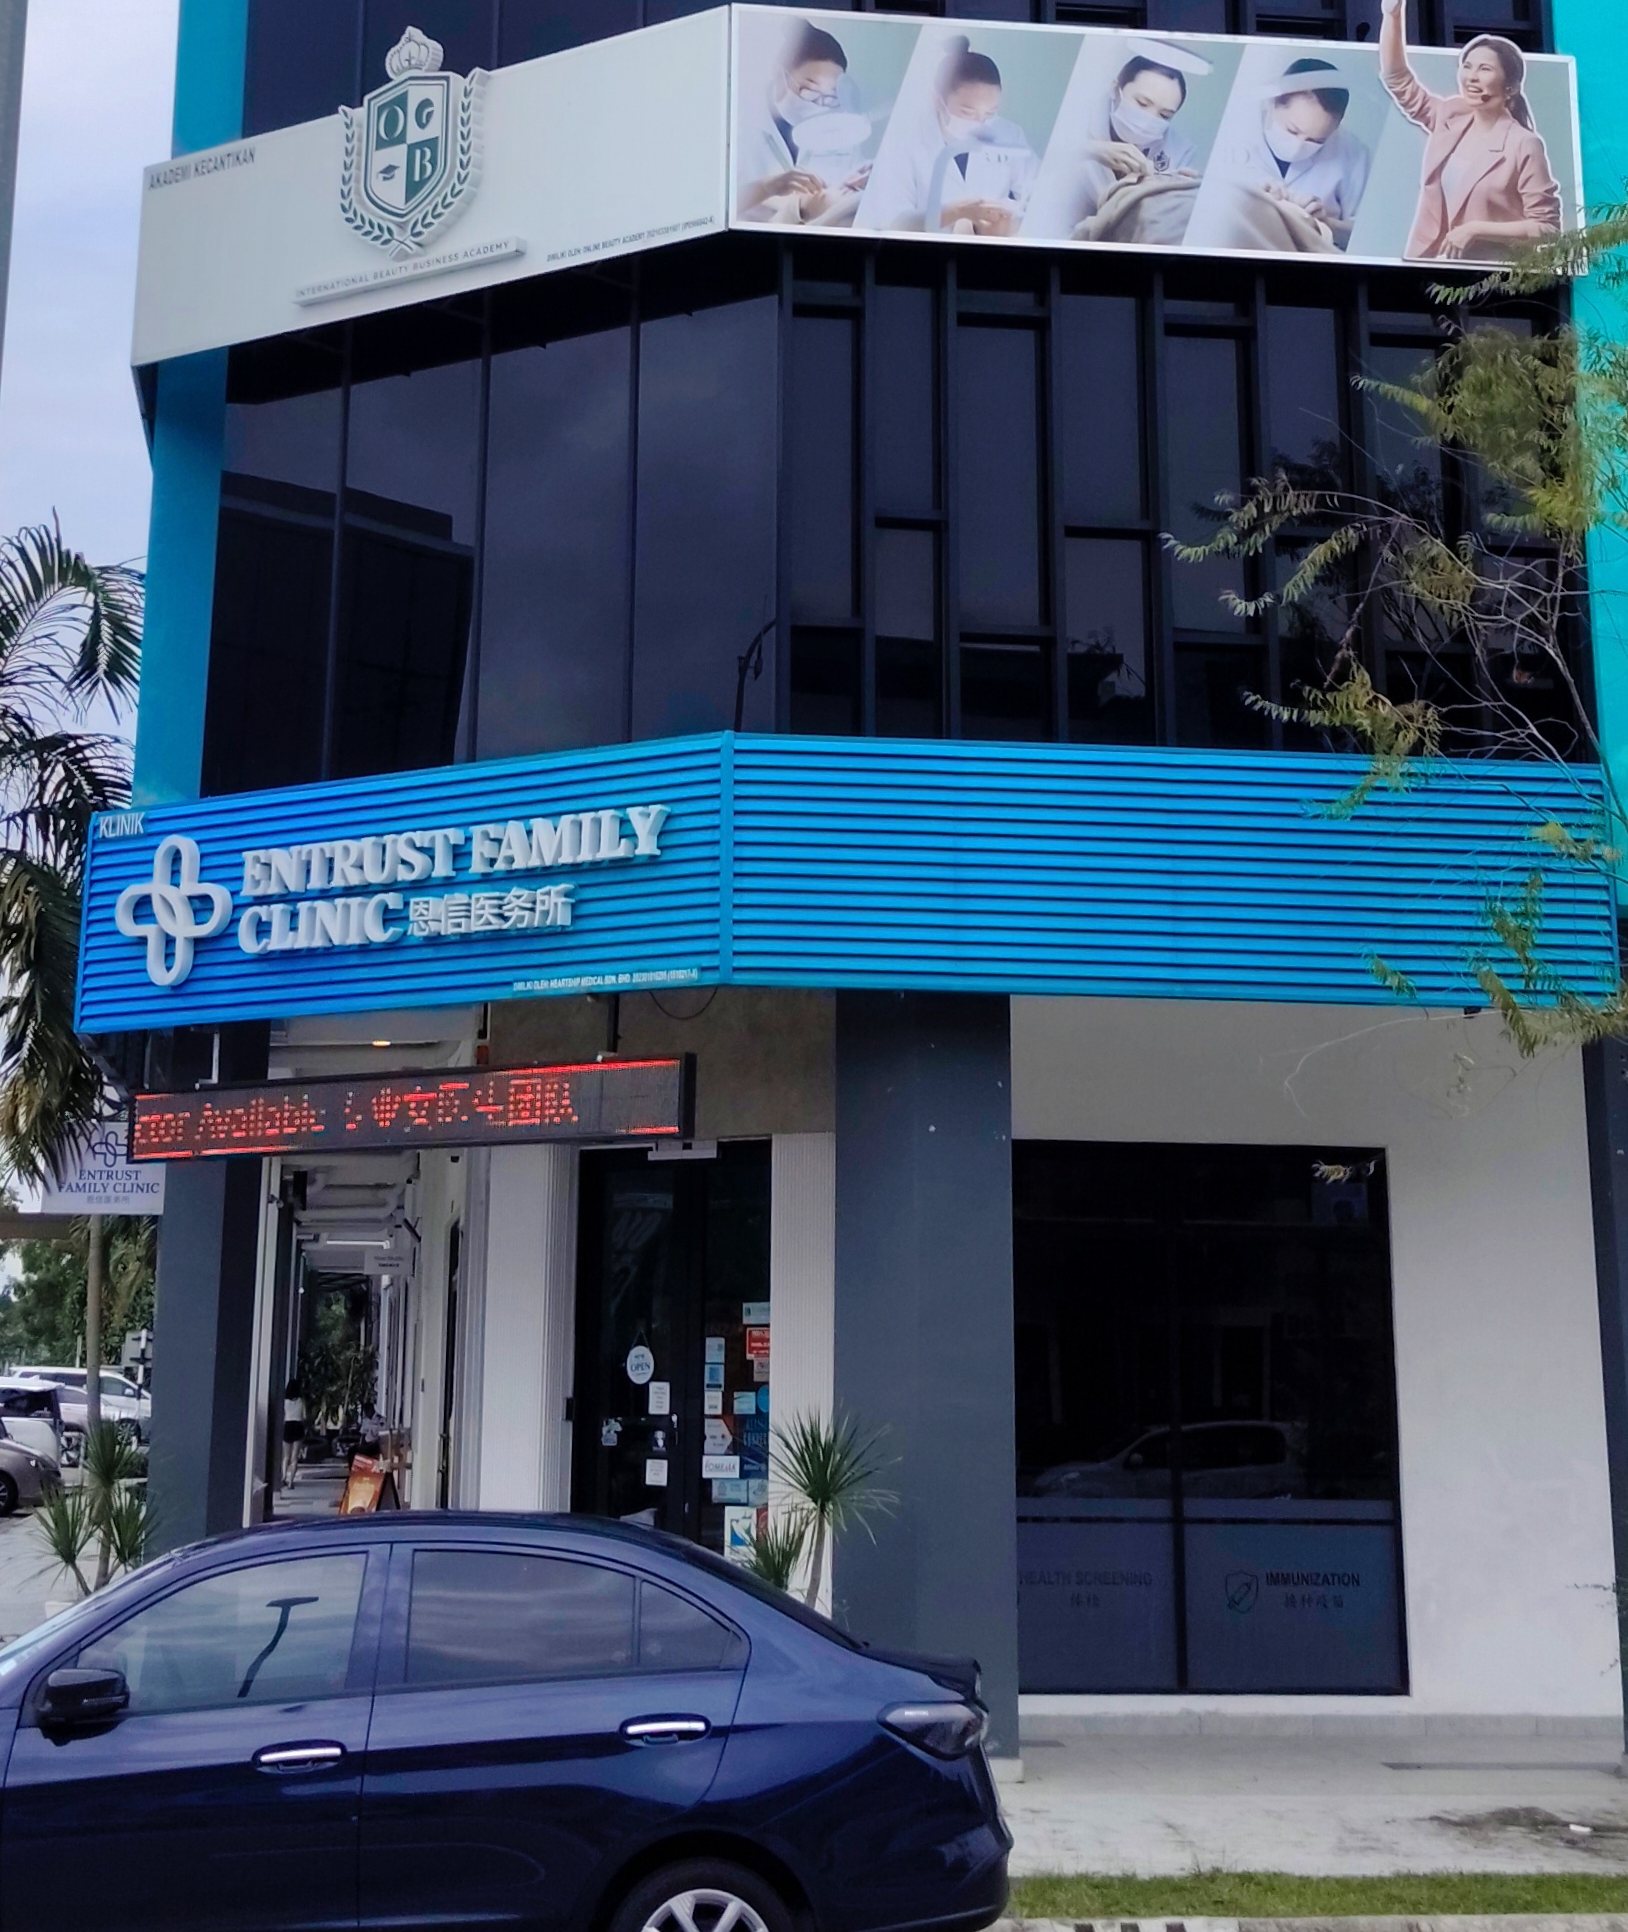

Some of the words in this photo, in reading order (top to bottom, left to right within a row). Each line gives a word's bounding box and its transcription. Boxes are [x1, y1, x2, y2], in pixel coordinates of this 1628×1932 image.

[149, 163, 192, 190] AKADEMI
[194, 146, 256, 178] KECANTIKAN
[296, 275, 370, 298] INTERNATIONAL
[373, 264, 410, 280] BEAUTY
[413, 253, 460, 271] BUSINESS
[463, 241, 510, 258] ACADEMY
[99, 811, 146, 838] KLINIK
[240, 828, 465, 897] ENTRUST
[468, 804, 671, 874] FAMILY
[238, 892, 404, 955] CLINIC
[407, 883, 576, 938] 恩信医务所
[580, 975, 604, 987] MEDICAL
[58, 1182, 109, 1194] FAMILY
[113, 1182, 160, 1194] CLINIC
[79, 1169, 141, 1181] ENTRUST
[1019, 1570, 1072, 1586] HEALTH
[1075, 1570, 1153, 1587] SCREENING
[1265, 1571, 1361, 1587] IMMUNIZATION
